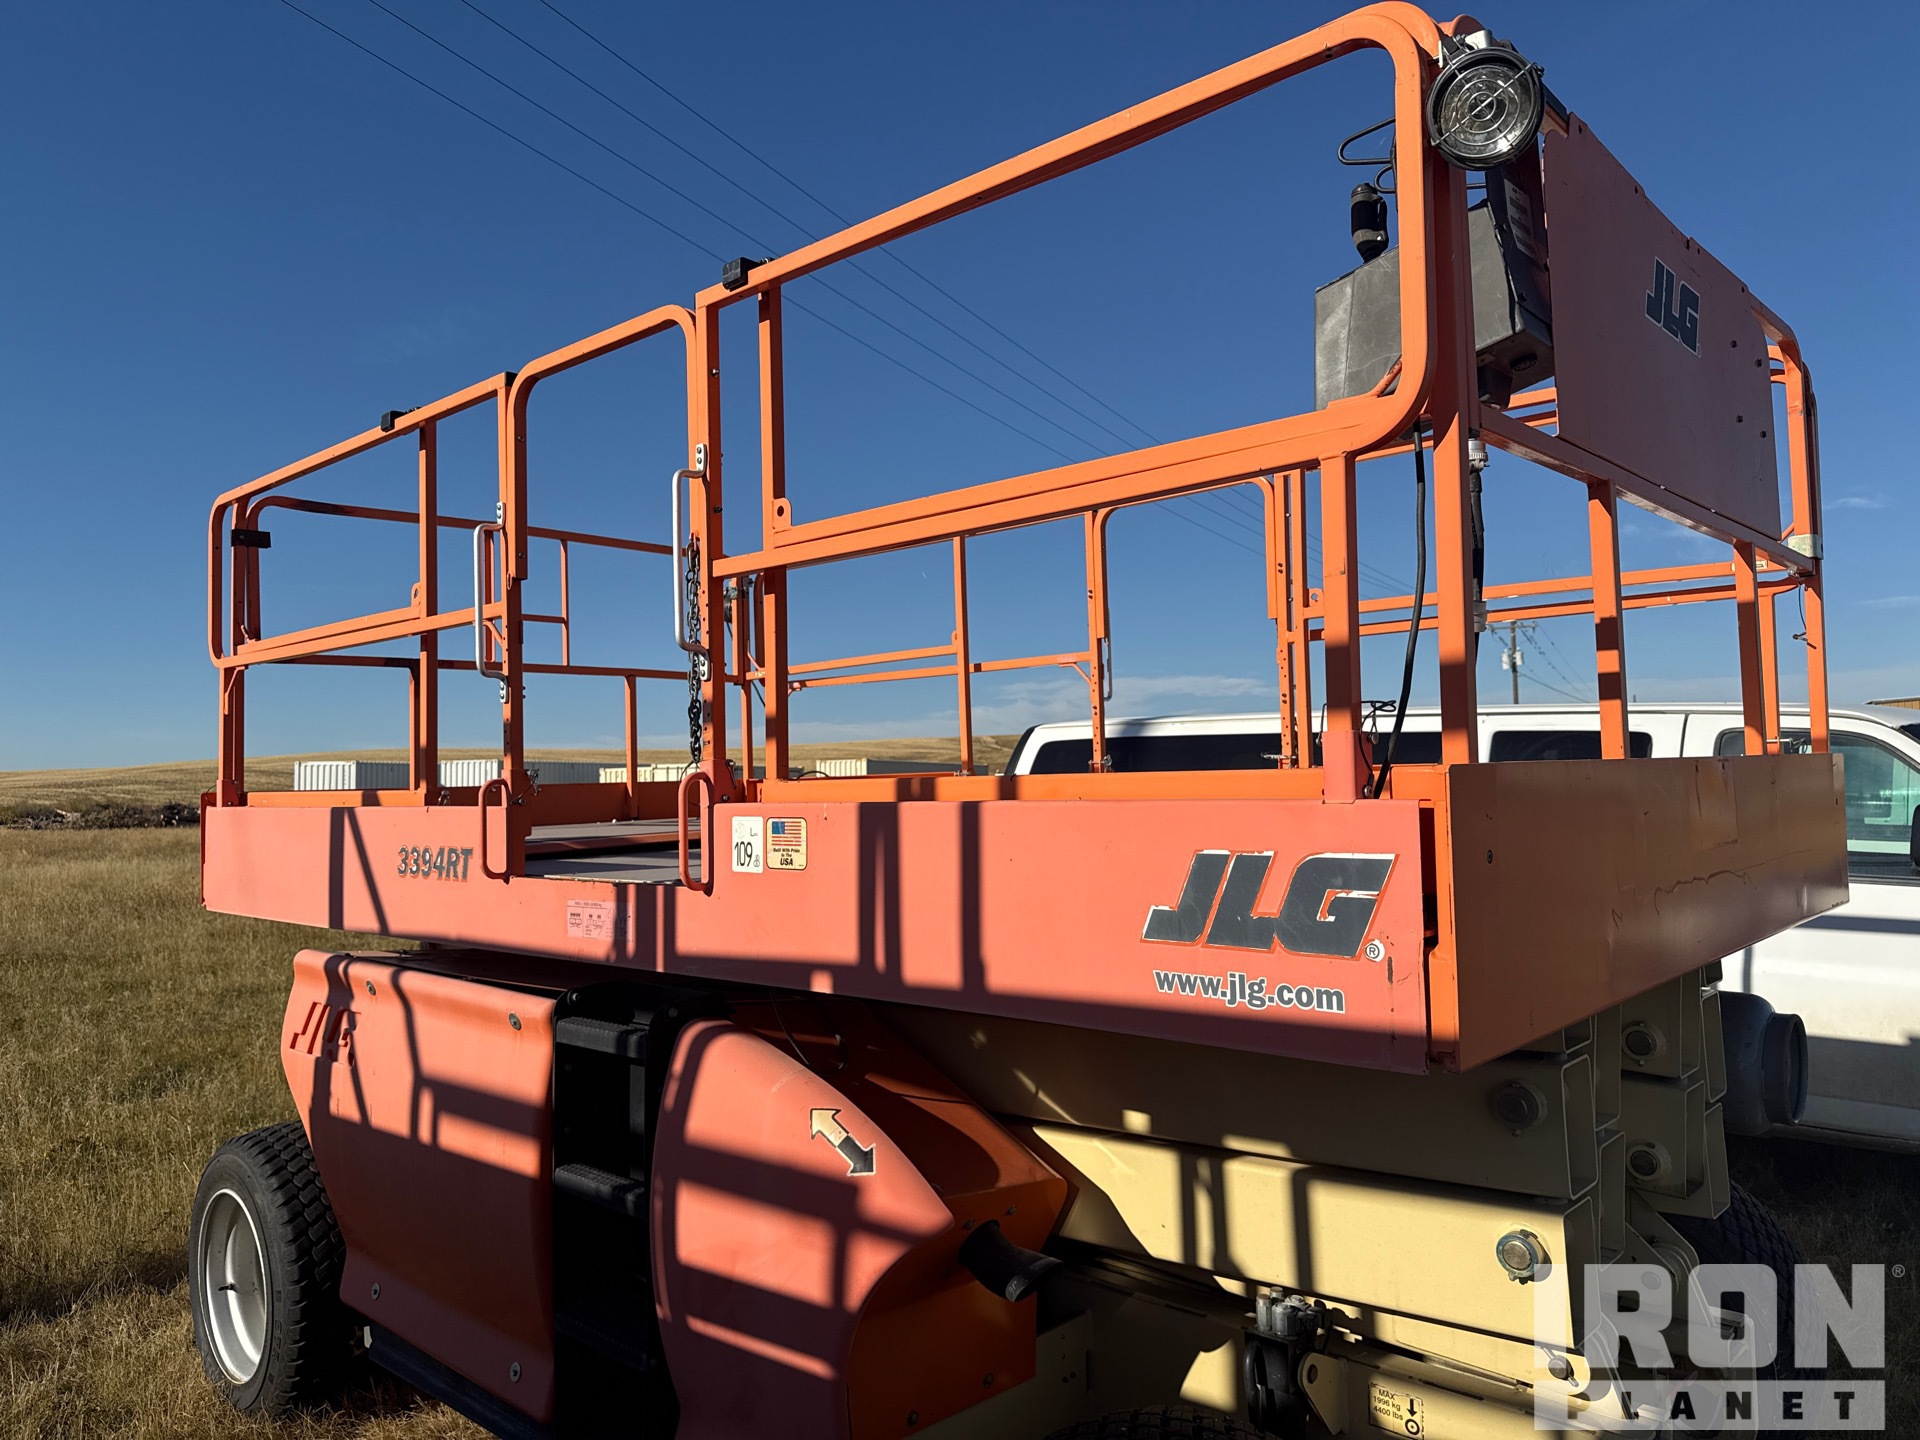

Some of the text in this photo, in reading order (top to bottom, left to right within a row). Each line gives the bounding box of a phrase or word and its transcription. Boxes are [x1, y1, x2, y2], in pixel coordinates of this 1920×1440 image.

[1645, 256, 1700, 356] JLG
[397, 845, 474, 882] 3394RT
[734, 841, 753, 867] 109
[779, 858, 794, 866] USA
[1140, 850, 1400, 962] JLG
[1153, 970, 1346, 1014] www.jlg.com
[1373, 1395, 1401, 1412] 1996 kg
[1379, 1389, 1395, 1401] MAX
[1373, 1405, 1404, 1421] 4400 lbs
